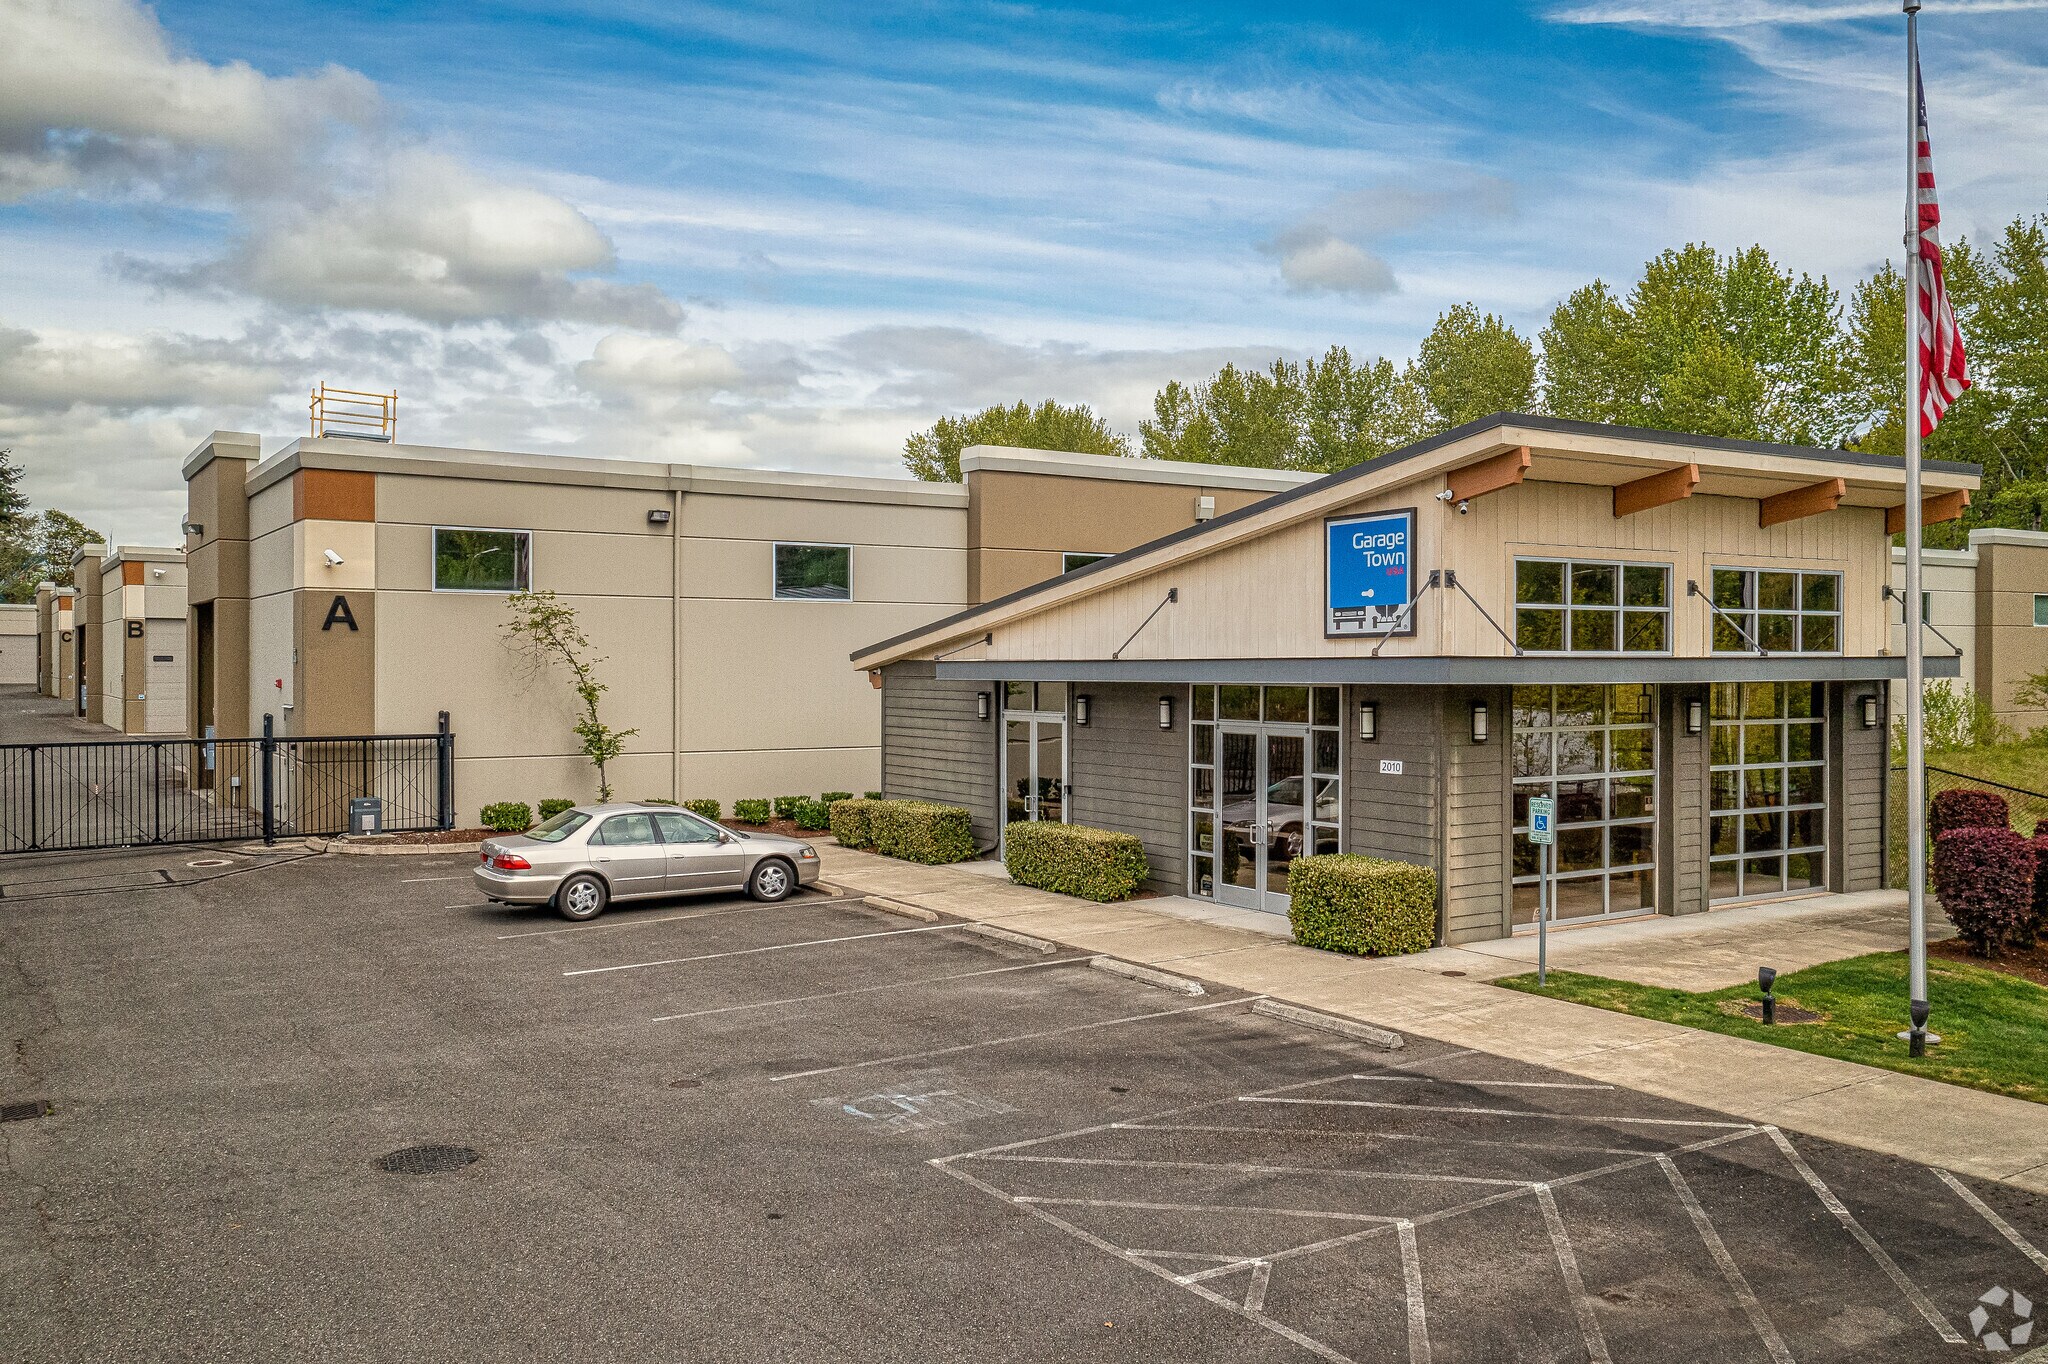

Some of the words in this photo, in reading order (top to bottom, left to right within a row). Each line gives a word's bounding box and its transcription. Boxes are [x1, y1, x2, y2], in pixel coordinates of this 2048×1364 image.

[1352, 532, 1405, 550] Garage
[1362, 551, 1405, 567] Town
[1386, 566, 1404, 576] USA
[321, 595, 359, 631] A
[61, 631, 72, 642] C
[127, 621, 145, 638] B
[1382, 762, 1401, 772] 2010
